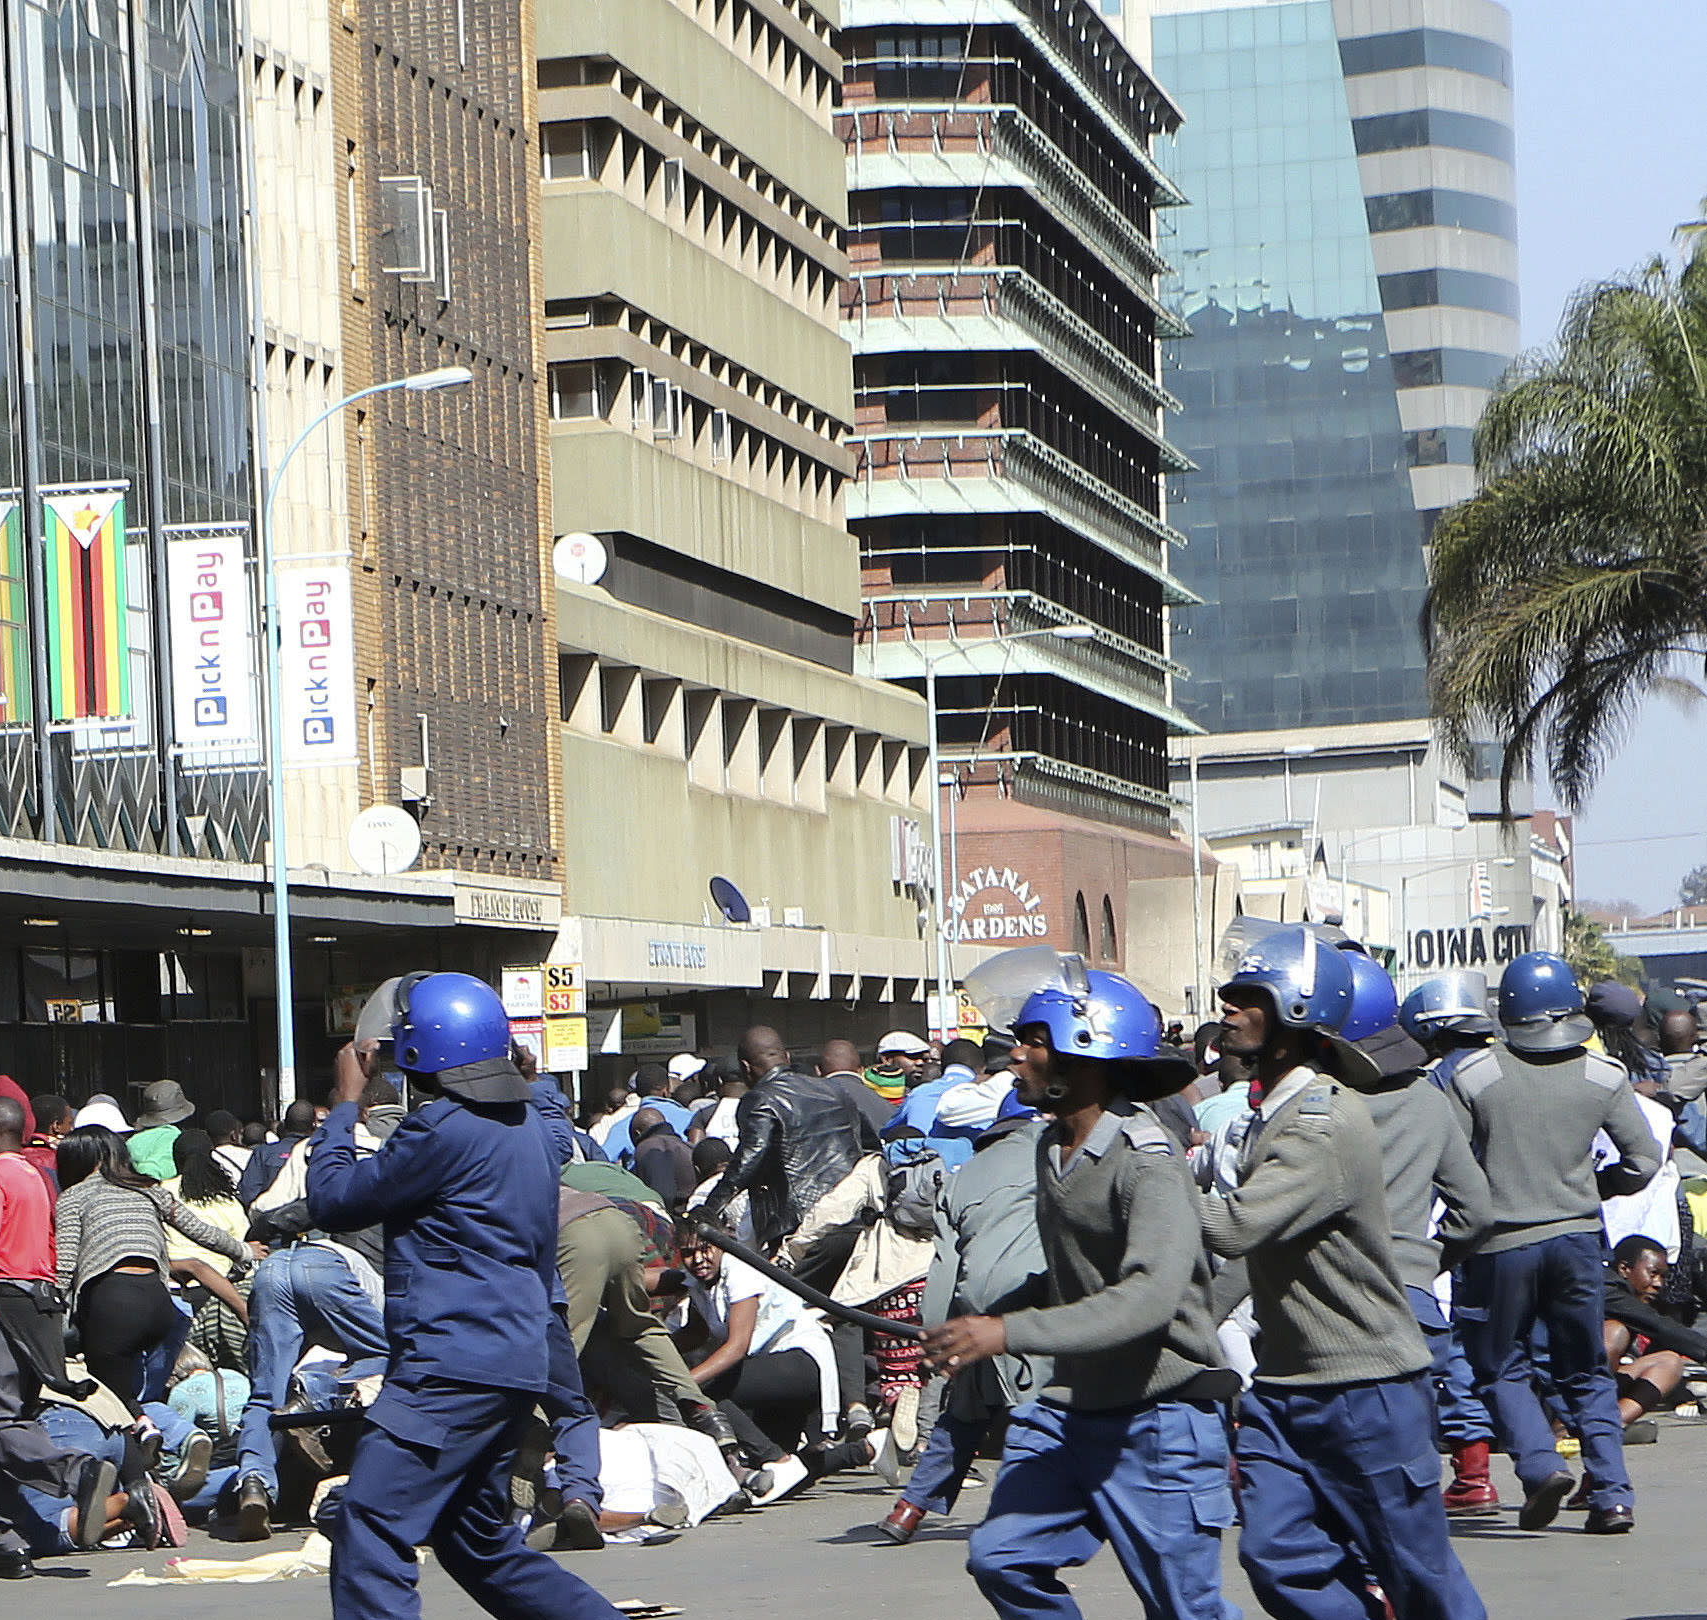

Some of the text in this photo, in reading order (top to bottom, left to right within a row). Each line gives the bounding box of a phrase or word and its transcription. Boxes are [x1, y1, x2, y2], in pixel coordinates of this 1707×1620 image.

[189, 551, 228, 728] Pick n Pay
[299, 579, 335, 745] Pick n Pay
[947, 865, 1042, 915] BATANAI
[942, 913, 1047, 941] GARDENS
[548, 966, 573, 988] $5
[549, 993, 571, 1011] $3
